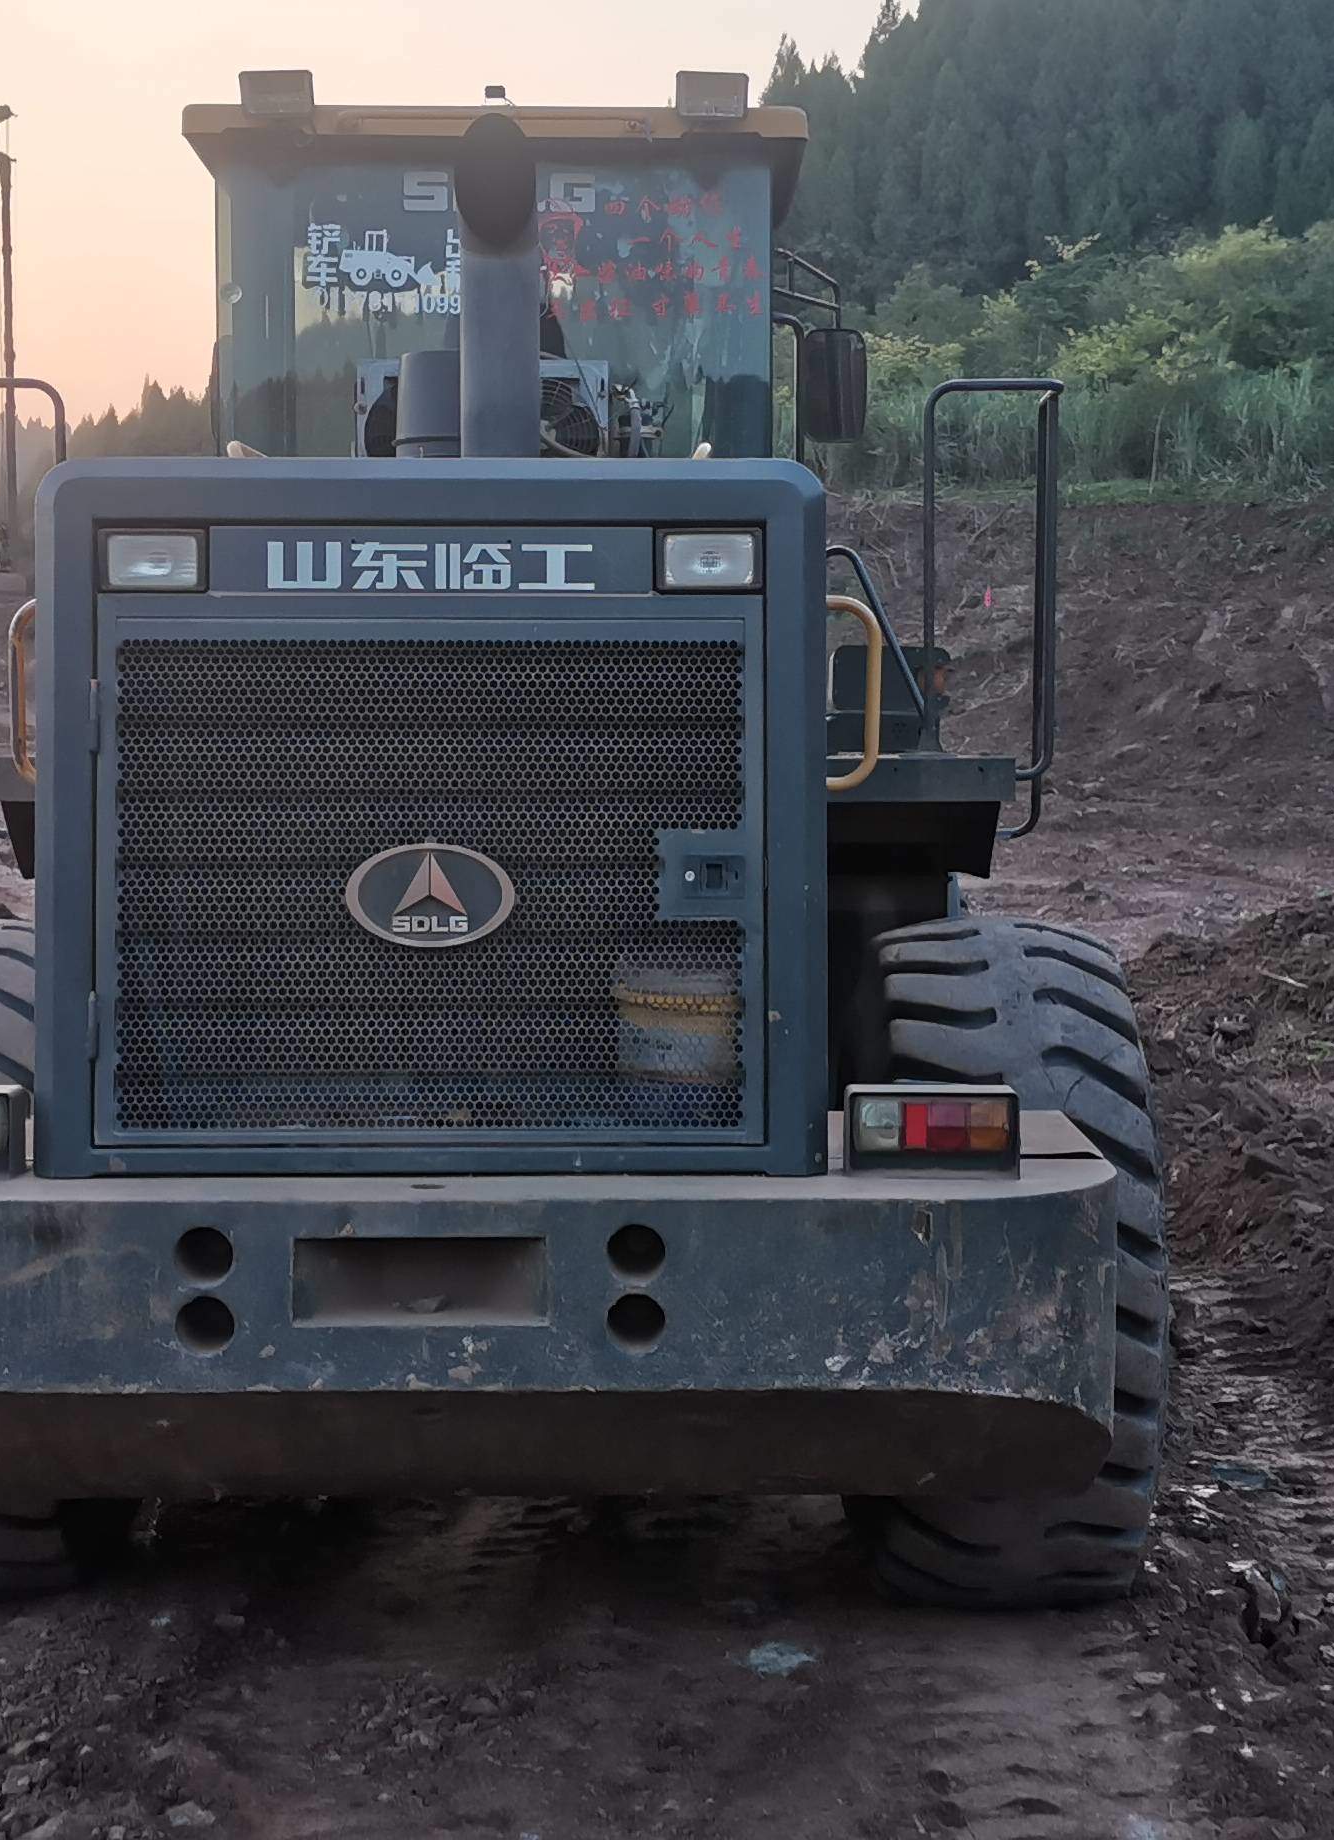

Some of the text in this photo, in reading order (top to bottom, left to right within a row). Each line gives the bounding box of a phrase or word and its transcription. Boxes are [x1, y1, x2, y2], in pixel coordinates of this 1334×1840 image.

[403, 171, 596, 213] SG
[307, 222, 341, 287] 铲车
[267, 541, 595, 590] 山东临工
[392, 915, 469, 933] SDLG
